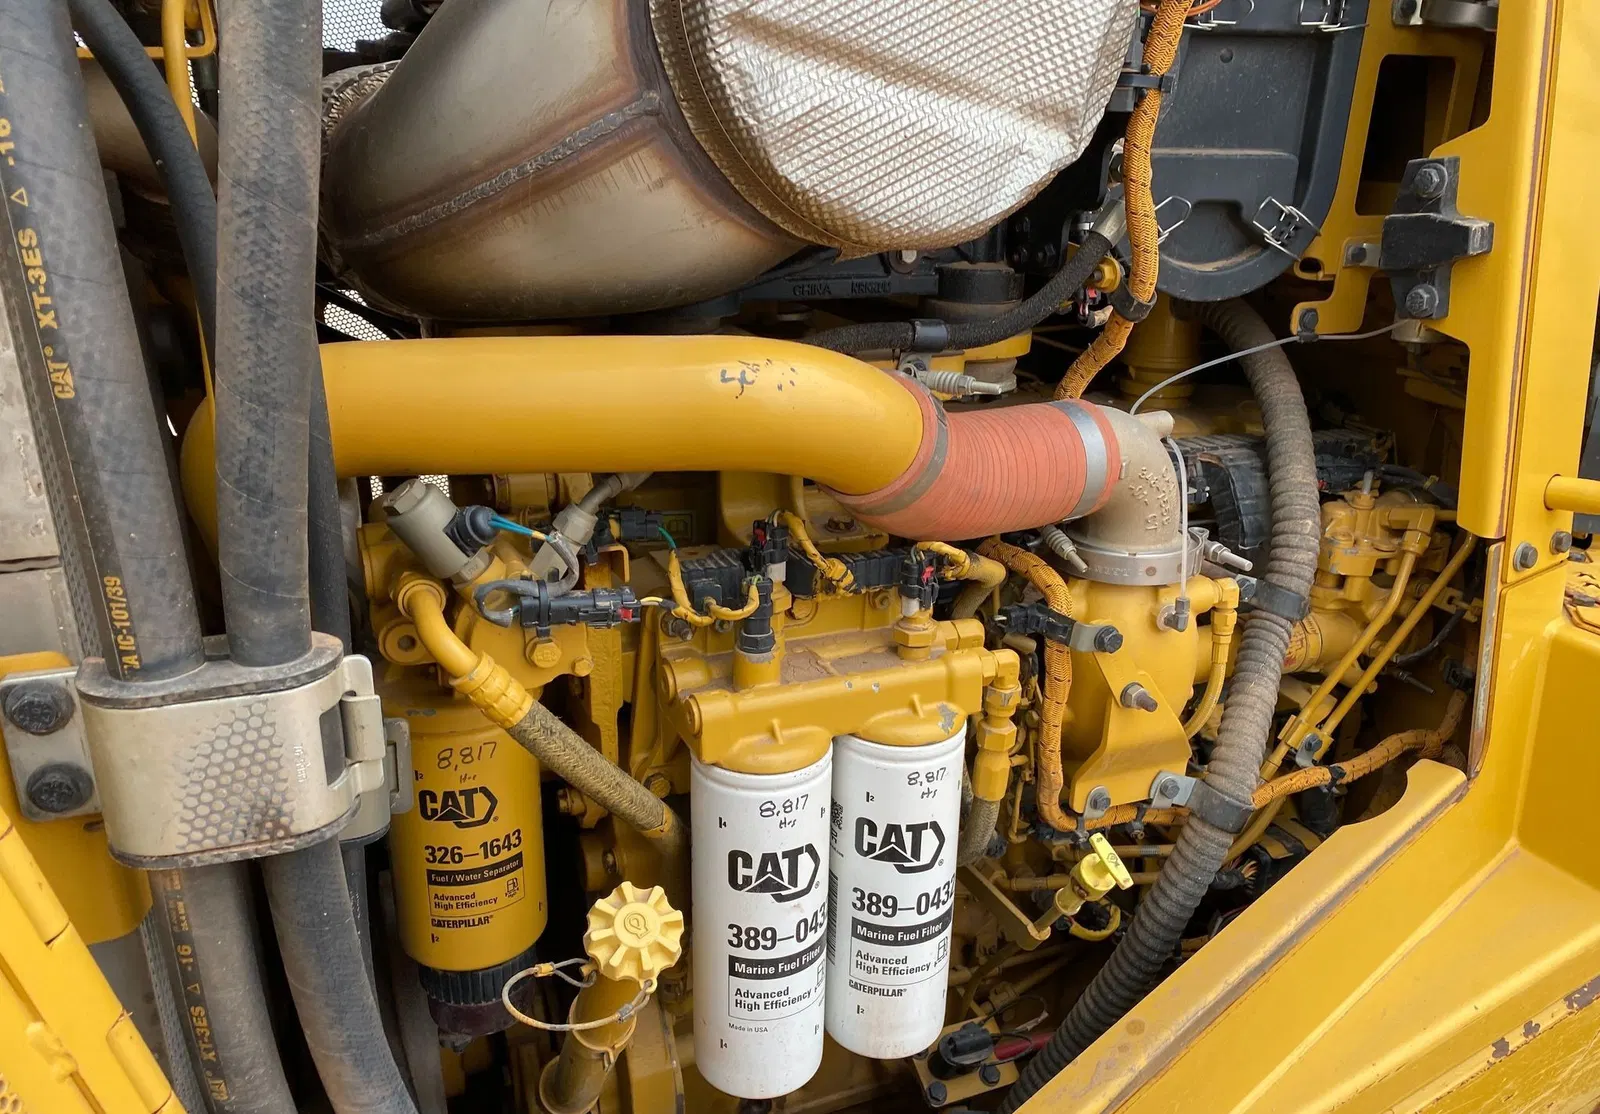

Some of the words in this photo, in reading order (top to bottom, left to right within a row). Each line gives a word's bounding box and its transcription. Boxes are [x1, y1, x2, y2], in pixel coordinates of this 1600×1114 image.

[18, 227, 58, 330] XT-3ES
[103, 576, 136, 651] IC-101/39
[437, 741, 497, 772] 8,817
[907, 767, 947, 787] 8,817
[759, 794, 809, 818] 8,817
[424, 828, 522, 865] 326-1643
[431, 873, 449, 883] Fuel
[454, 872, 481, 882] Water
[483, 859, 520, 878] Separator
[433, 892, 476, 901] Advanced
[434, 901, 454, 912] High
[455, 897, 499, 910] Efficiency
[857, 925, 895, 941] Marine
[897, 930, 919, 942] Fuel
[921, 922, 943, 938] Filter
[177, 944, 194, 972] -16
[734, 962, 776, 975] Marine
[778, 958, 800, 973] Fuel
[801, 946, 821, 965] Filter
[855, 949, 908, 965] Advanced
[855, 960, 879, 974] High
[881, 962, 931, 976] Efficiency
[734, 986, 790, 999] Advanced
[735, 999, 761, 1012] High
[763, 989, 812, 1010] Efficiency
[190, 1005, 217, 1062] XT-3ES
[728, 1022, 746, 1031] Made
